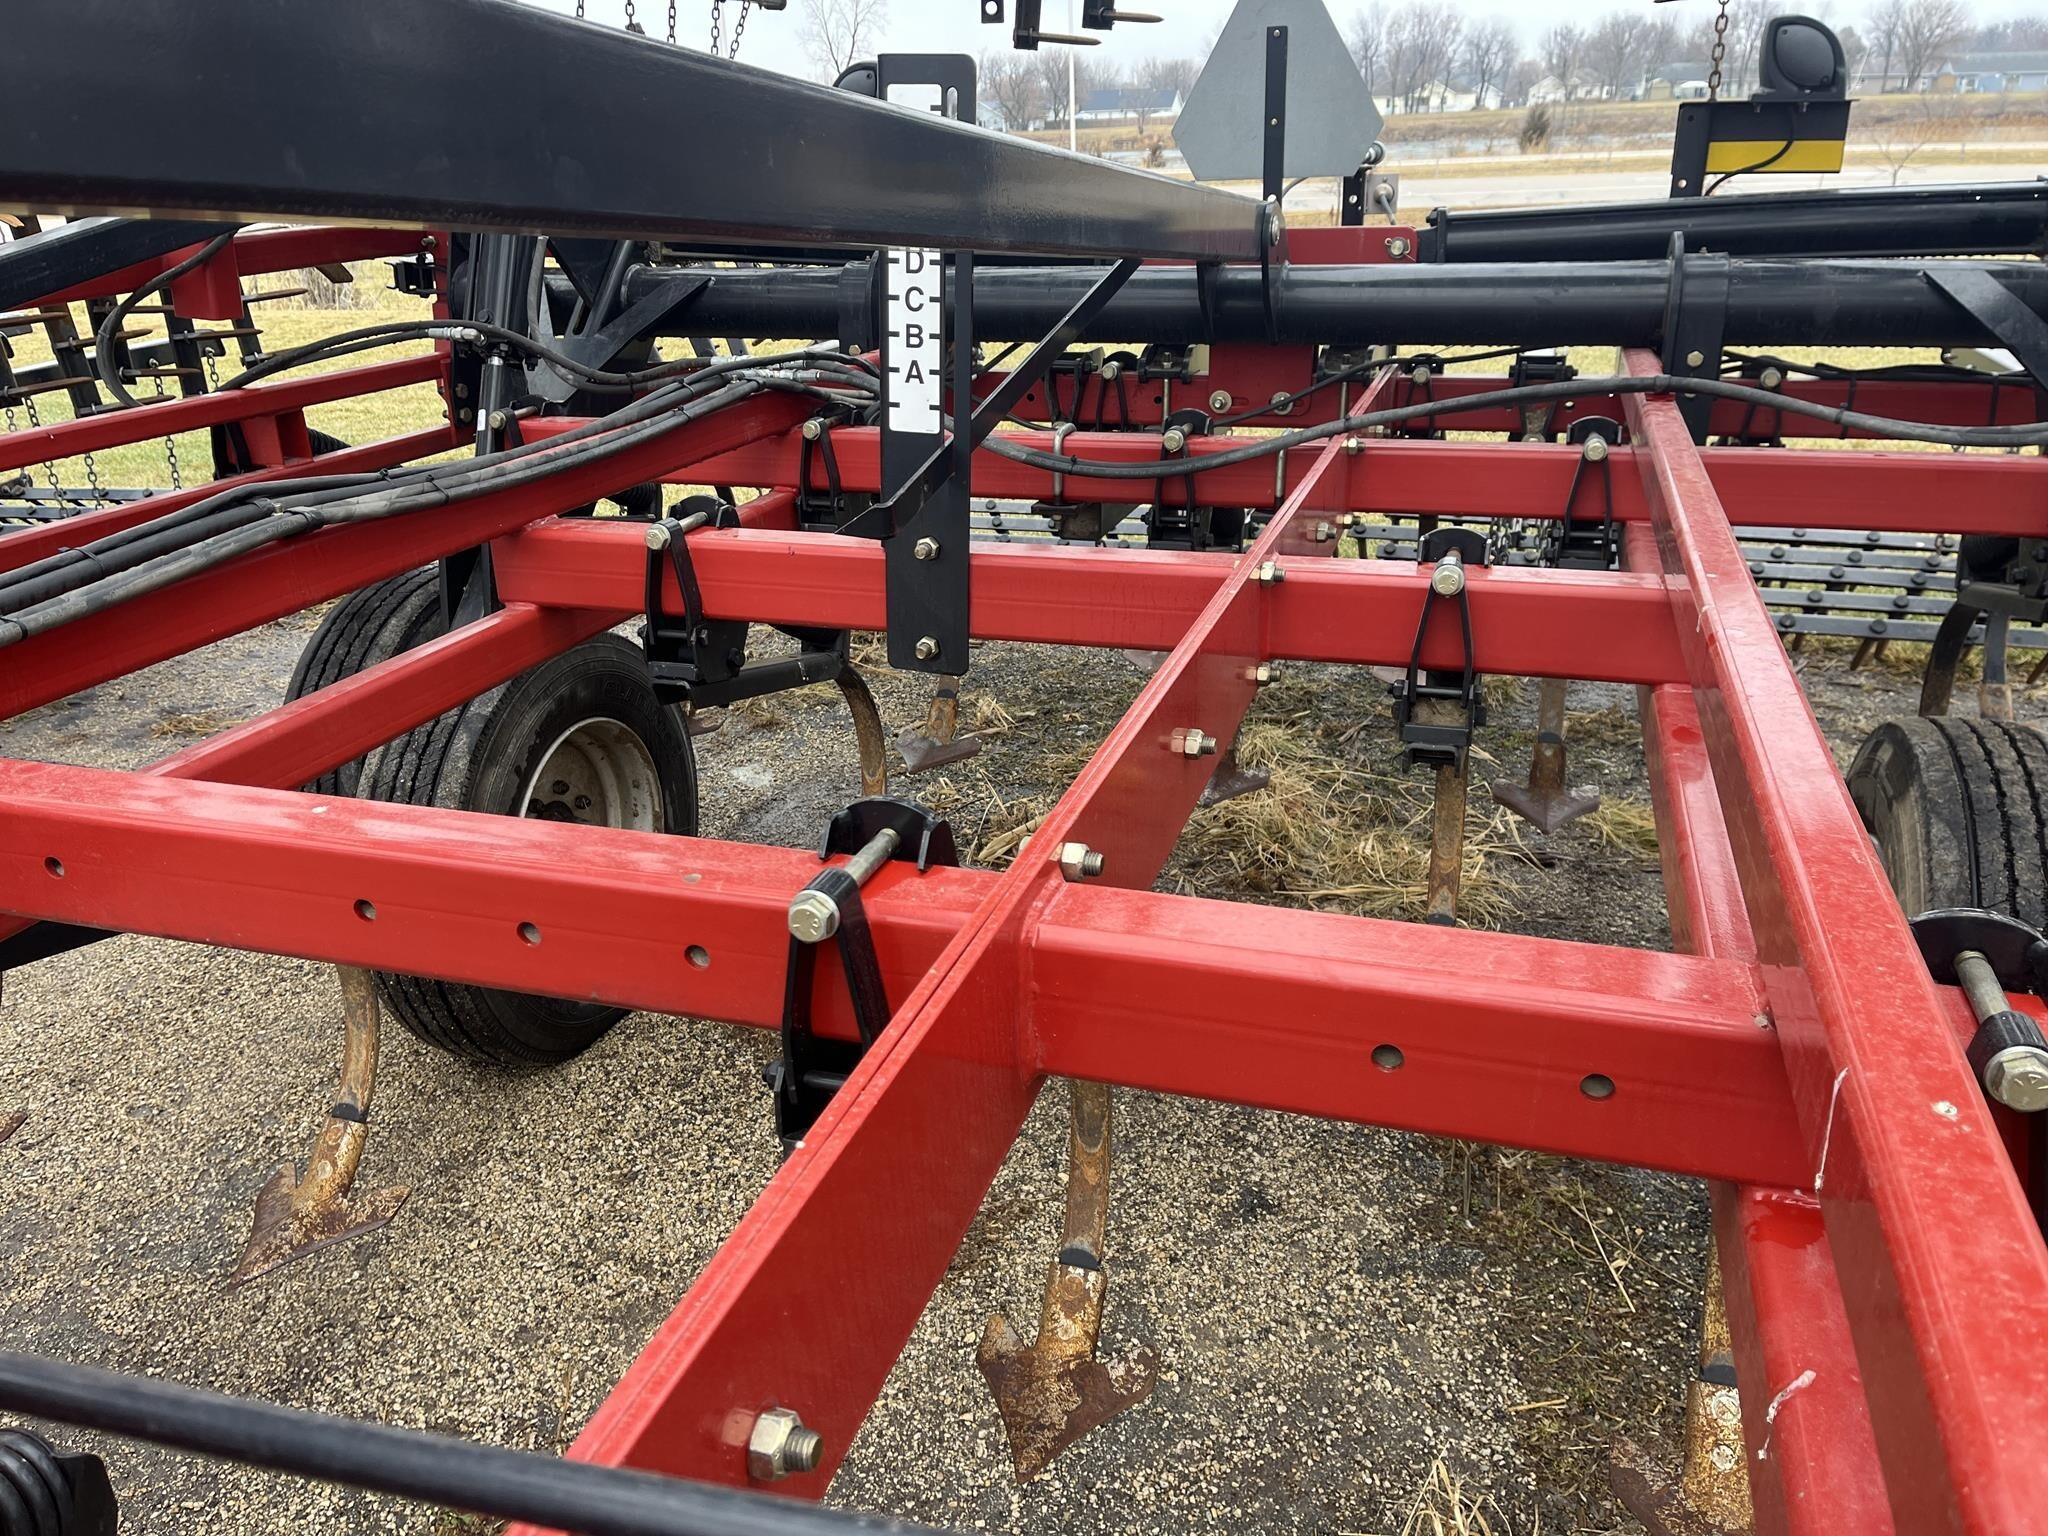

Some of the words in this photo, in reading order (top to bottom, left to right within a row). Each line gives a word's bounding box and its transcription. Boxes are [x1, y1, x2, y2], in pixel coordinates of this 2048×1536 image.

[905, 249, 924, 274] D
[904, 286, 925, 312] C
[905, 323, 924, 349] B
[904, 359, 925, 385] A
